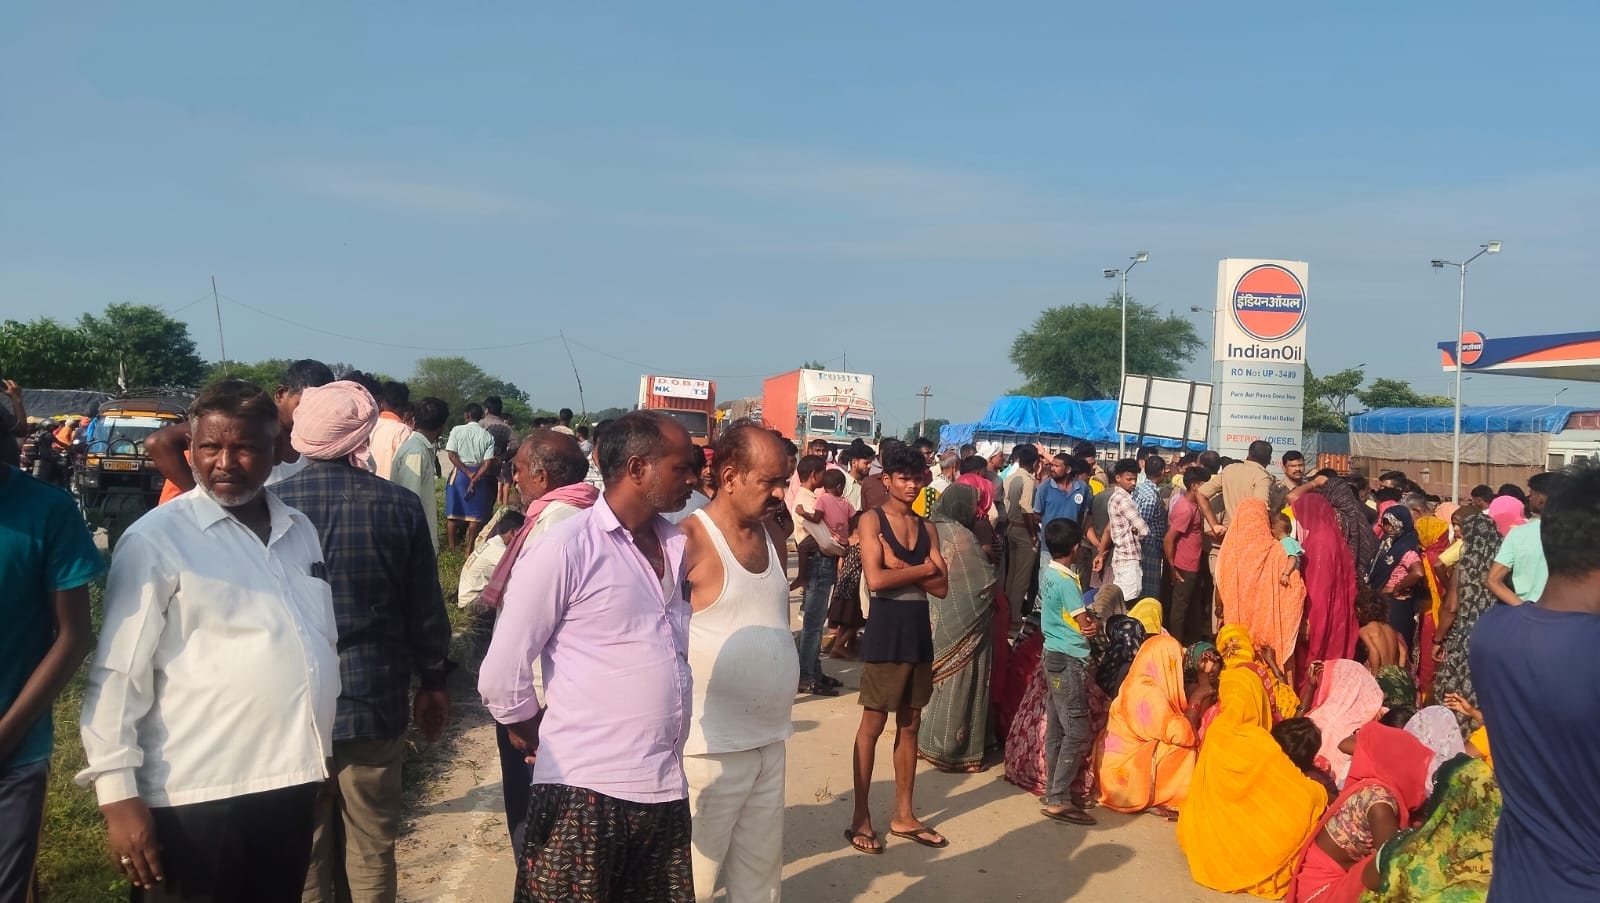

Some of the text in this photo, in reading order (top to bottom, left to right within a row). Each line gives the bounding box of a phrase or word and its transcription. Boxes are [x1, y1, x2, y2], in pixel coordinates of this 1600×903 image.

[1237, 294, 1301, 309] इंडियनऑयल
[1228, 344, 1301, 360] IndianOil
[1231, 368, 1243, 376] RO
